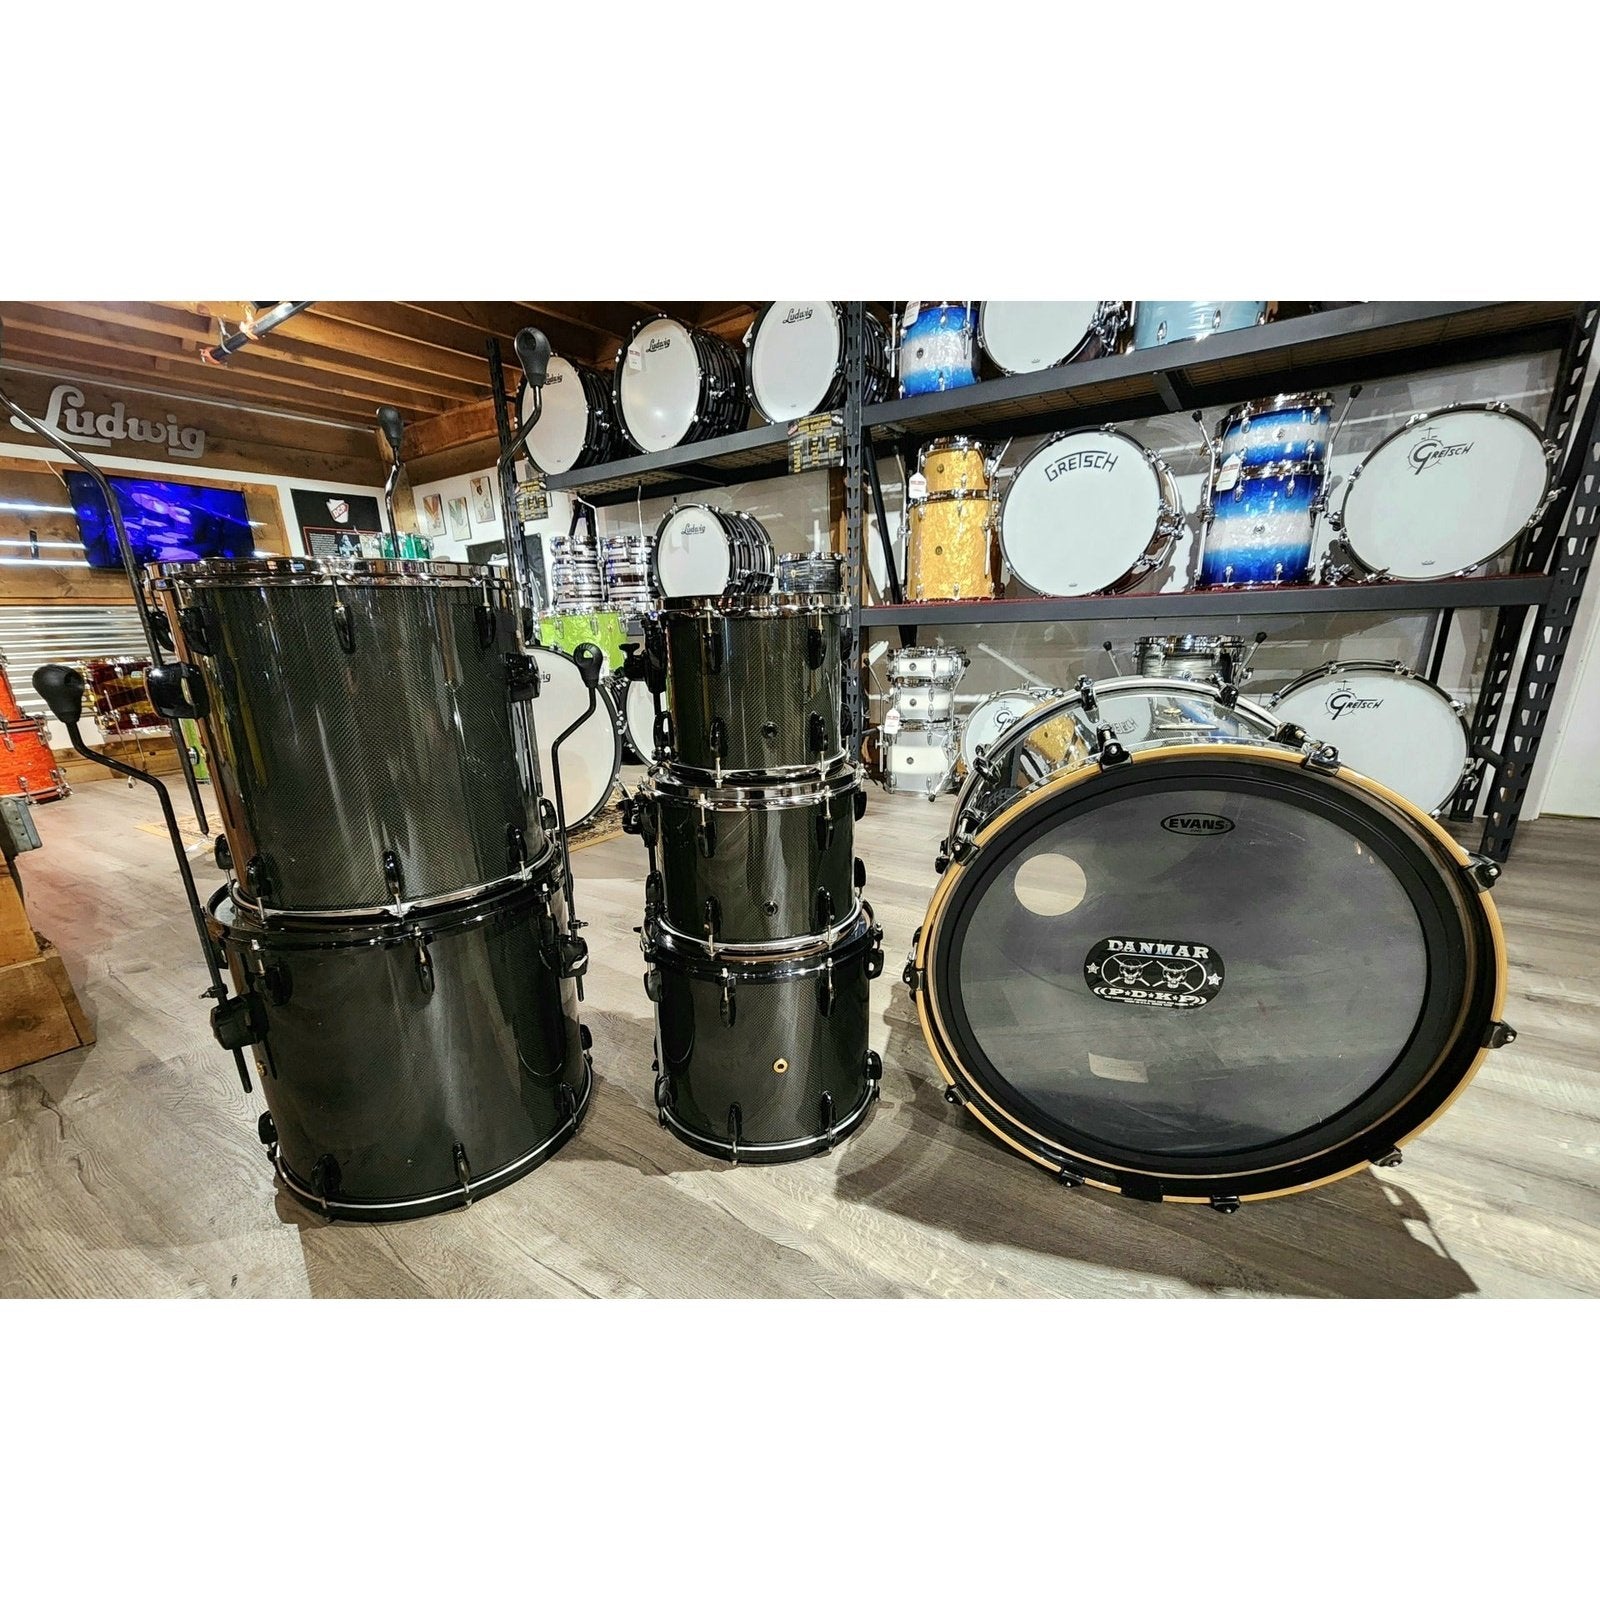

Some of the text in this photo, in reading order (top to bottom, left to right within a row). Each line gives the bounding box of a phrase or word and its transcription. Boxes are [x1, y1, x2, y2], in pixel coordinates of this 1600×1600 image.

[782, 307, 813, 324] Ludwig
[645, 338, 671, 353] Ludwig
[10, 384, 206, 459] Ludwig
[1044, 450, 1119, 482] GRETSCH
[681, 522, 706, 536] Ludwig
[1169, 818, 1225, 830] EVANS
[1107, 939, 1210, 959] DANMAR
